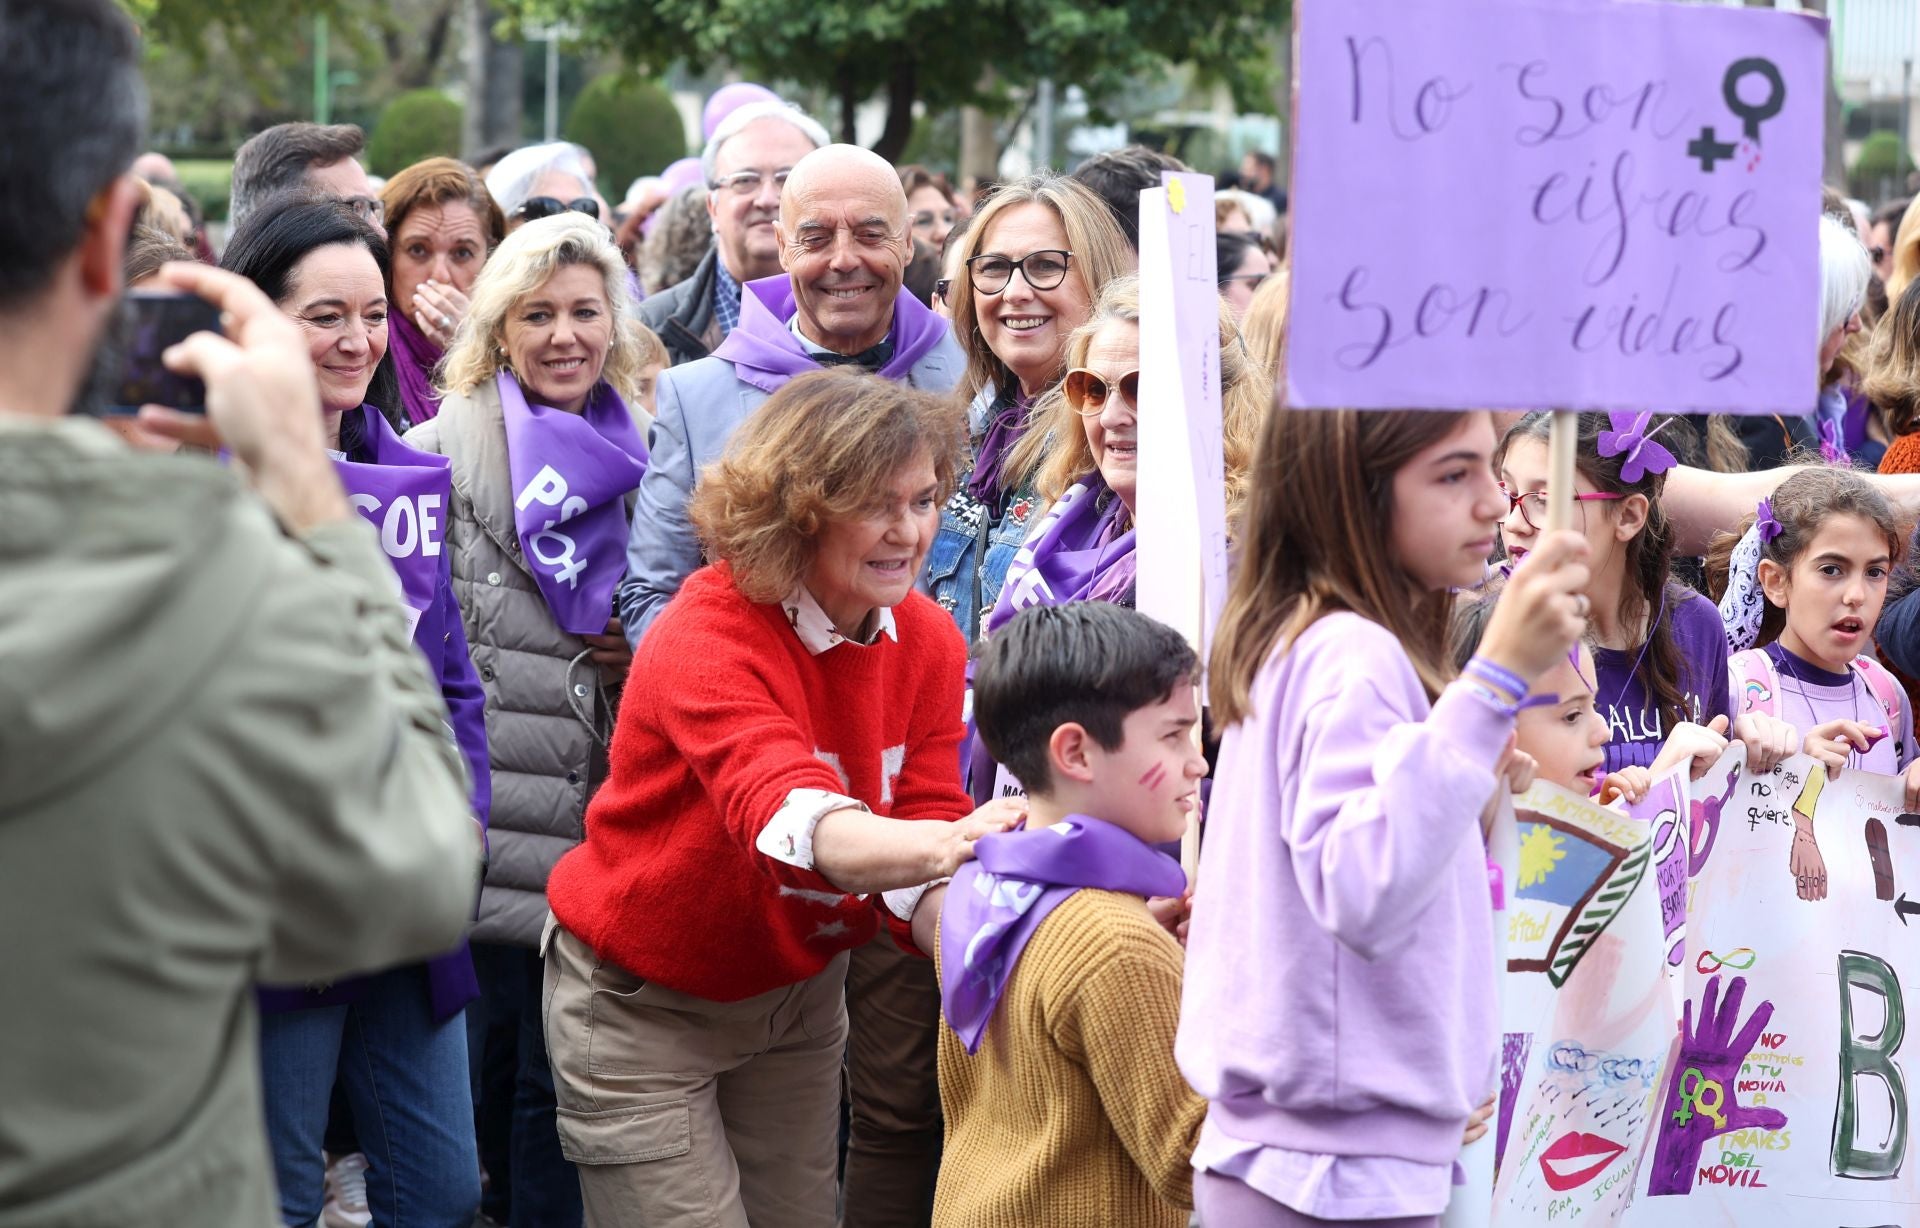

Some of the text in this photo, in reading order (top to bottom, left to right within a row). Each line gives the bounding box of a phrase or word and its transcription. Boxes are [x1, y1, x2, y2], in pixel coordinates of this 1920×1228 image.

[1751, 782, 1772, 797] no
[1799, 874, 1826, 889] STOP
[1761, 1033, 1787, 1049] NO
[1741, 1063, 1782, 1078] A TU
[1737, 1080, 1786, 1093] NOVIA
[1752, 1092, 1767, 1105] A
[1721, 1151, 1763, 1168] DEL
[1699, 1165, 1768, 1188] MOVIL
